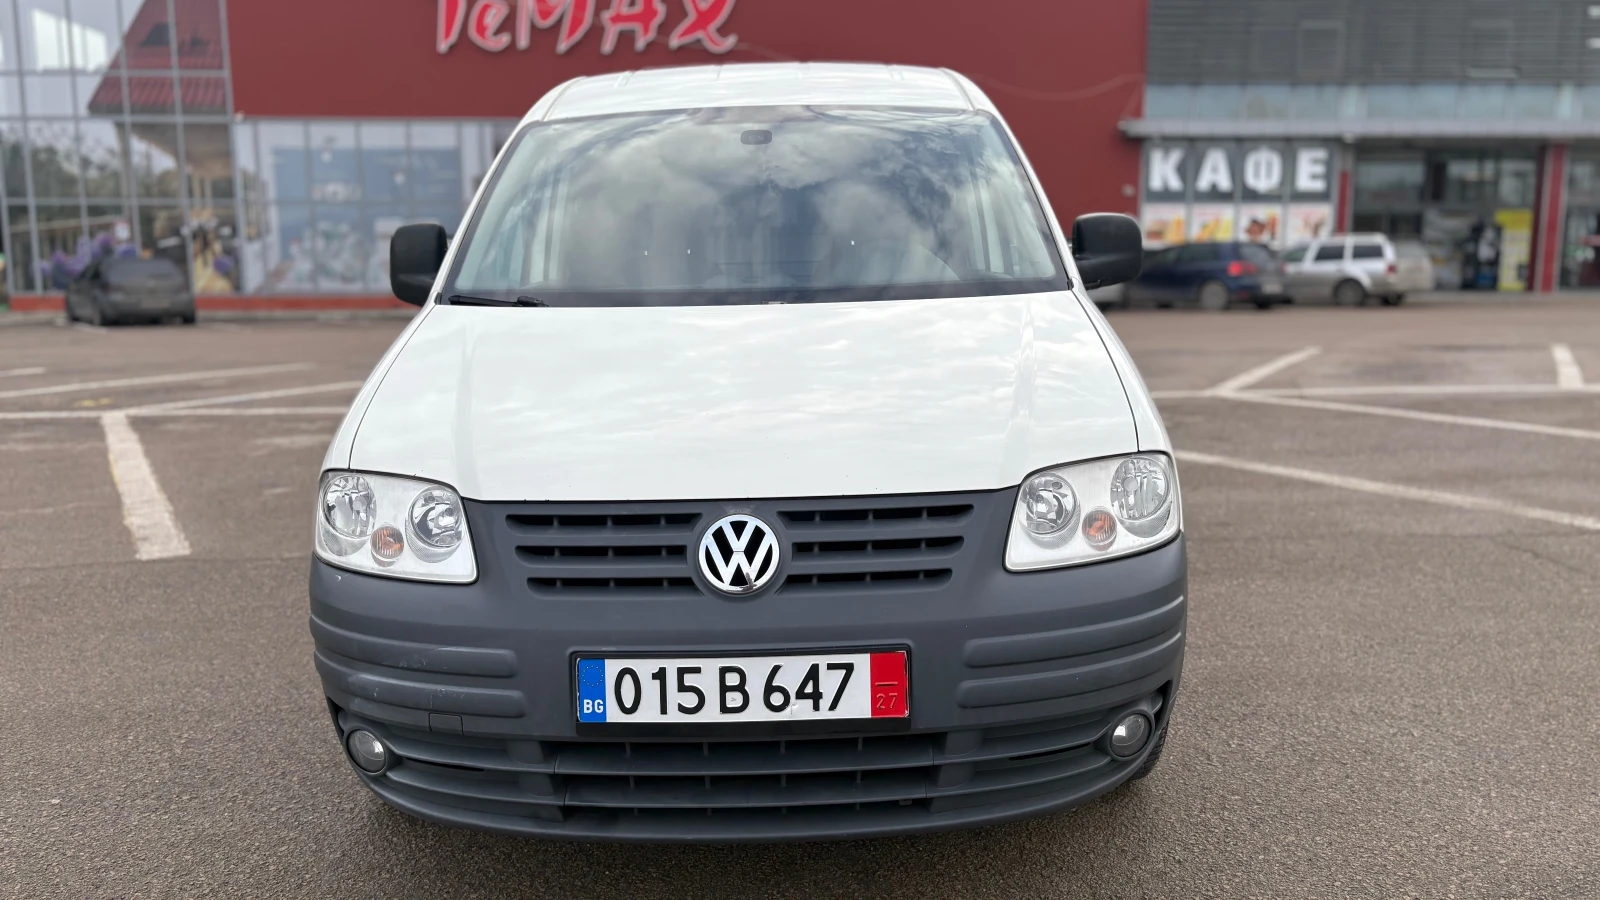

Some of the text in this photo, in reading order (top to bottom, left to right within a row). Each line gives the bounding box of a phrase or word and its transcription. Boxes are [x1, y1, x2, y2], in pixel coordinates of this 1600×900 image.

[1148, 146, 1328, 194] КАФЕ
[583, 699, 604, 714] BG
[876, 693, 898, 709] 27
